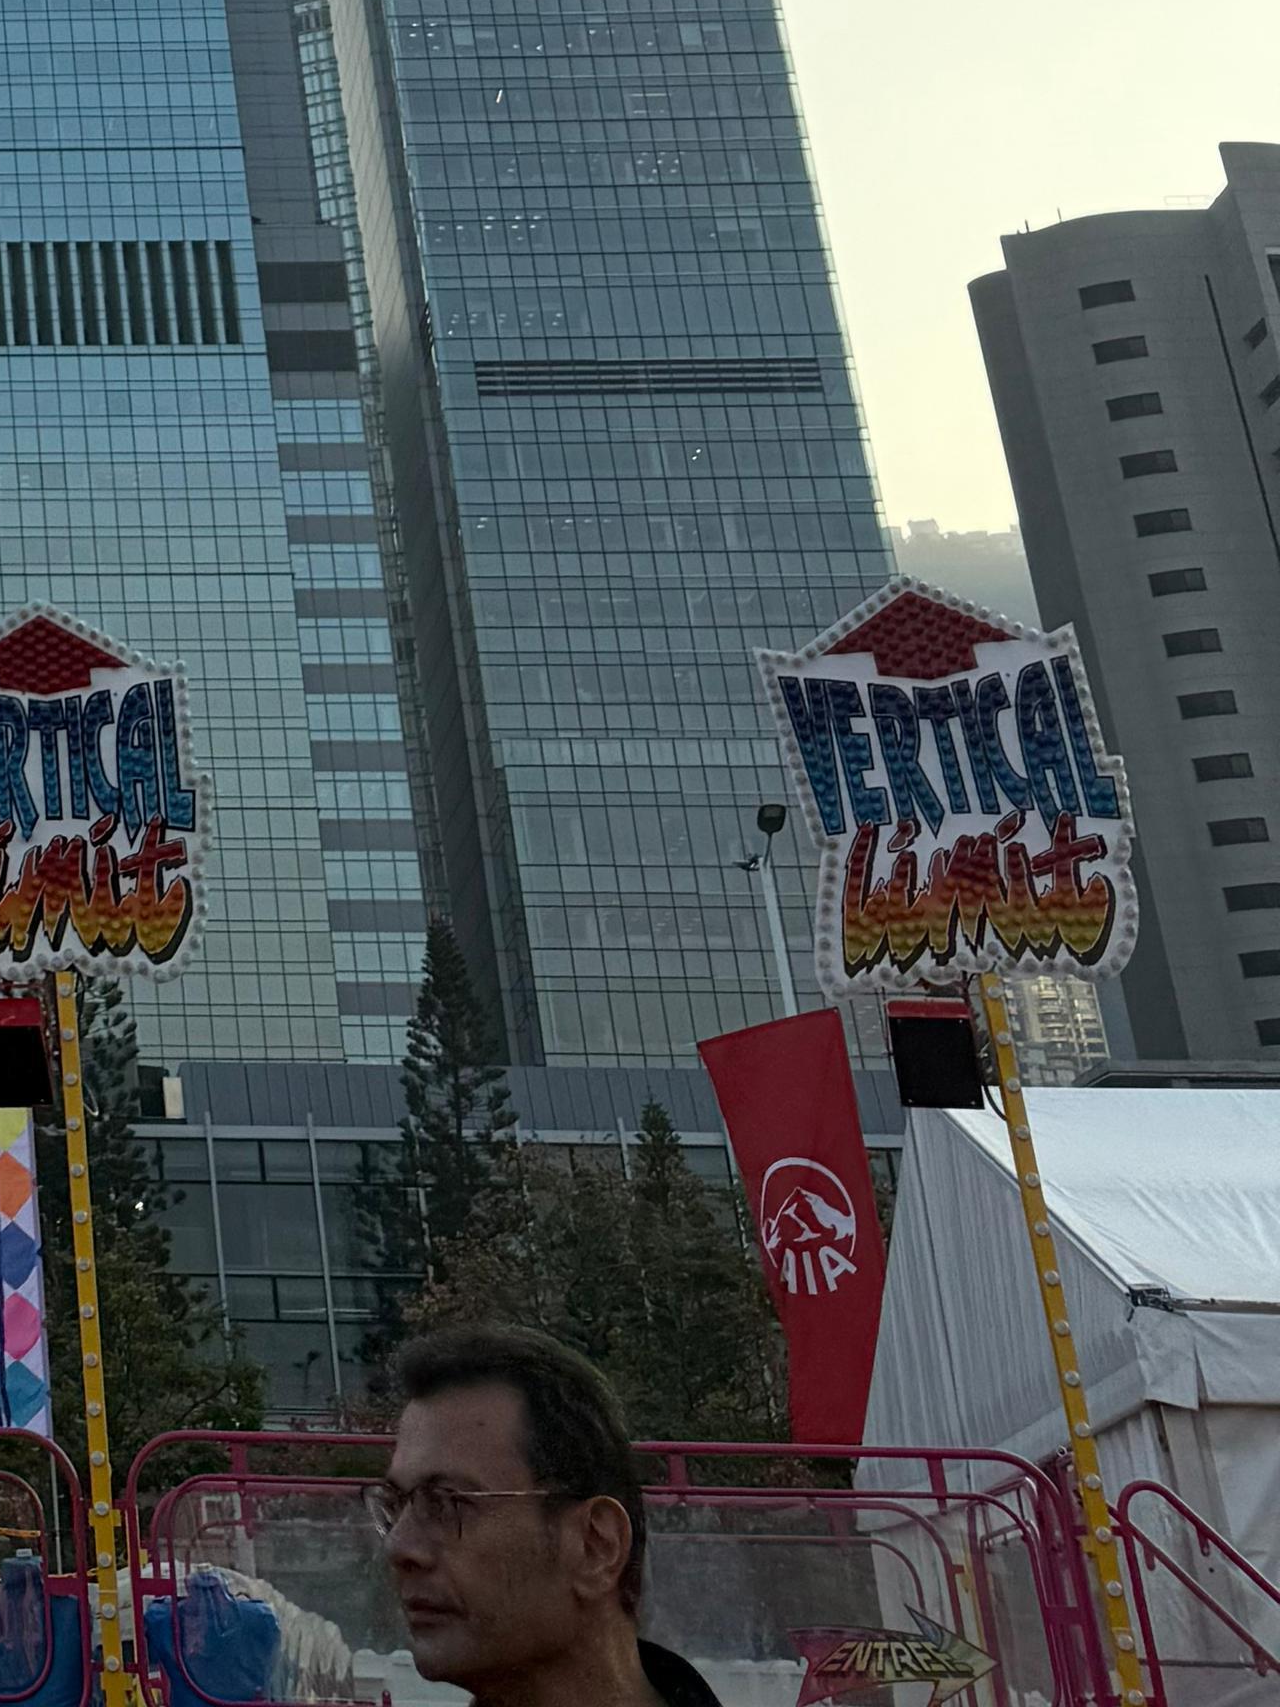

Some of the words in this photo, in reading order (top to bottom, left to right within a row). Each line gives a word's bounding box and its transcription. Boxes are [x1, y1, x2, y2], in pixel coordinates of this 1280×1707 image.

[778, 655, 1121, 838] VERTICAL
[843, 809, 1116, 979] Limit
[781, 1246, 857, 1295] AIA
